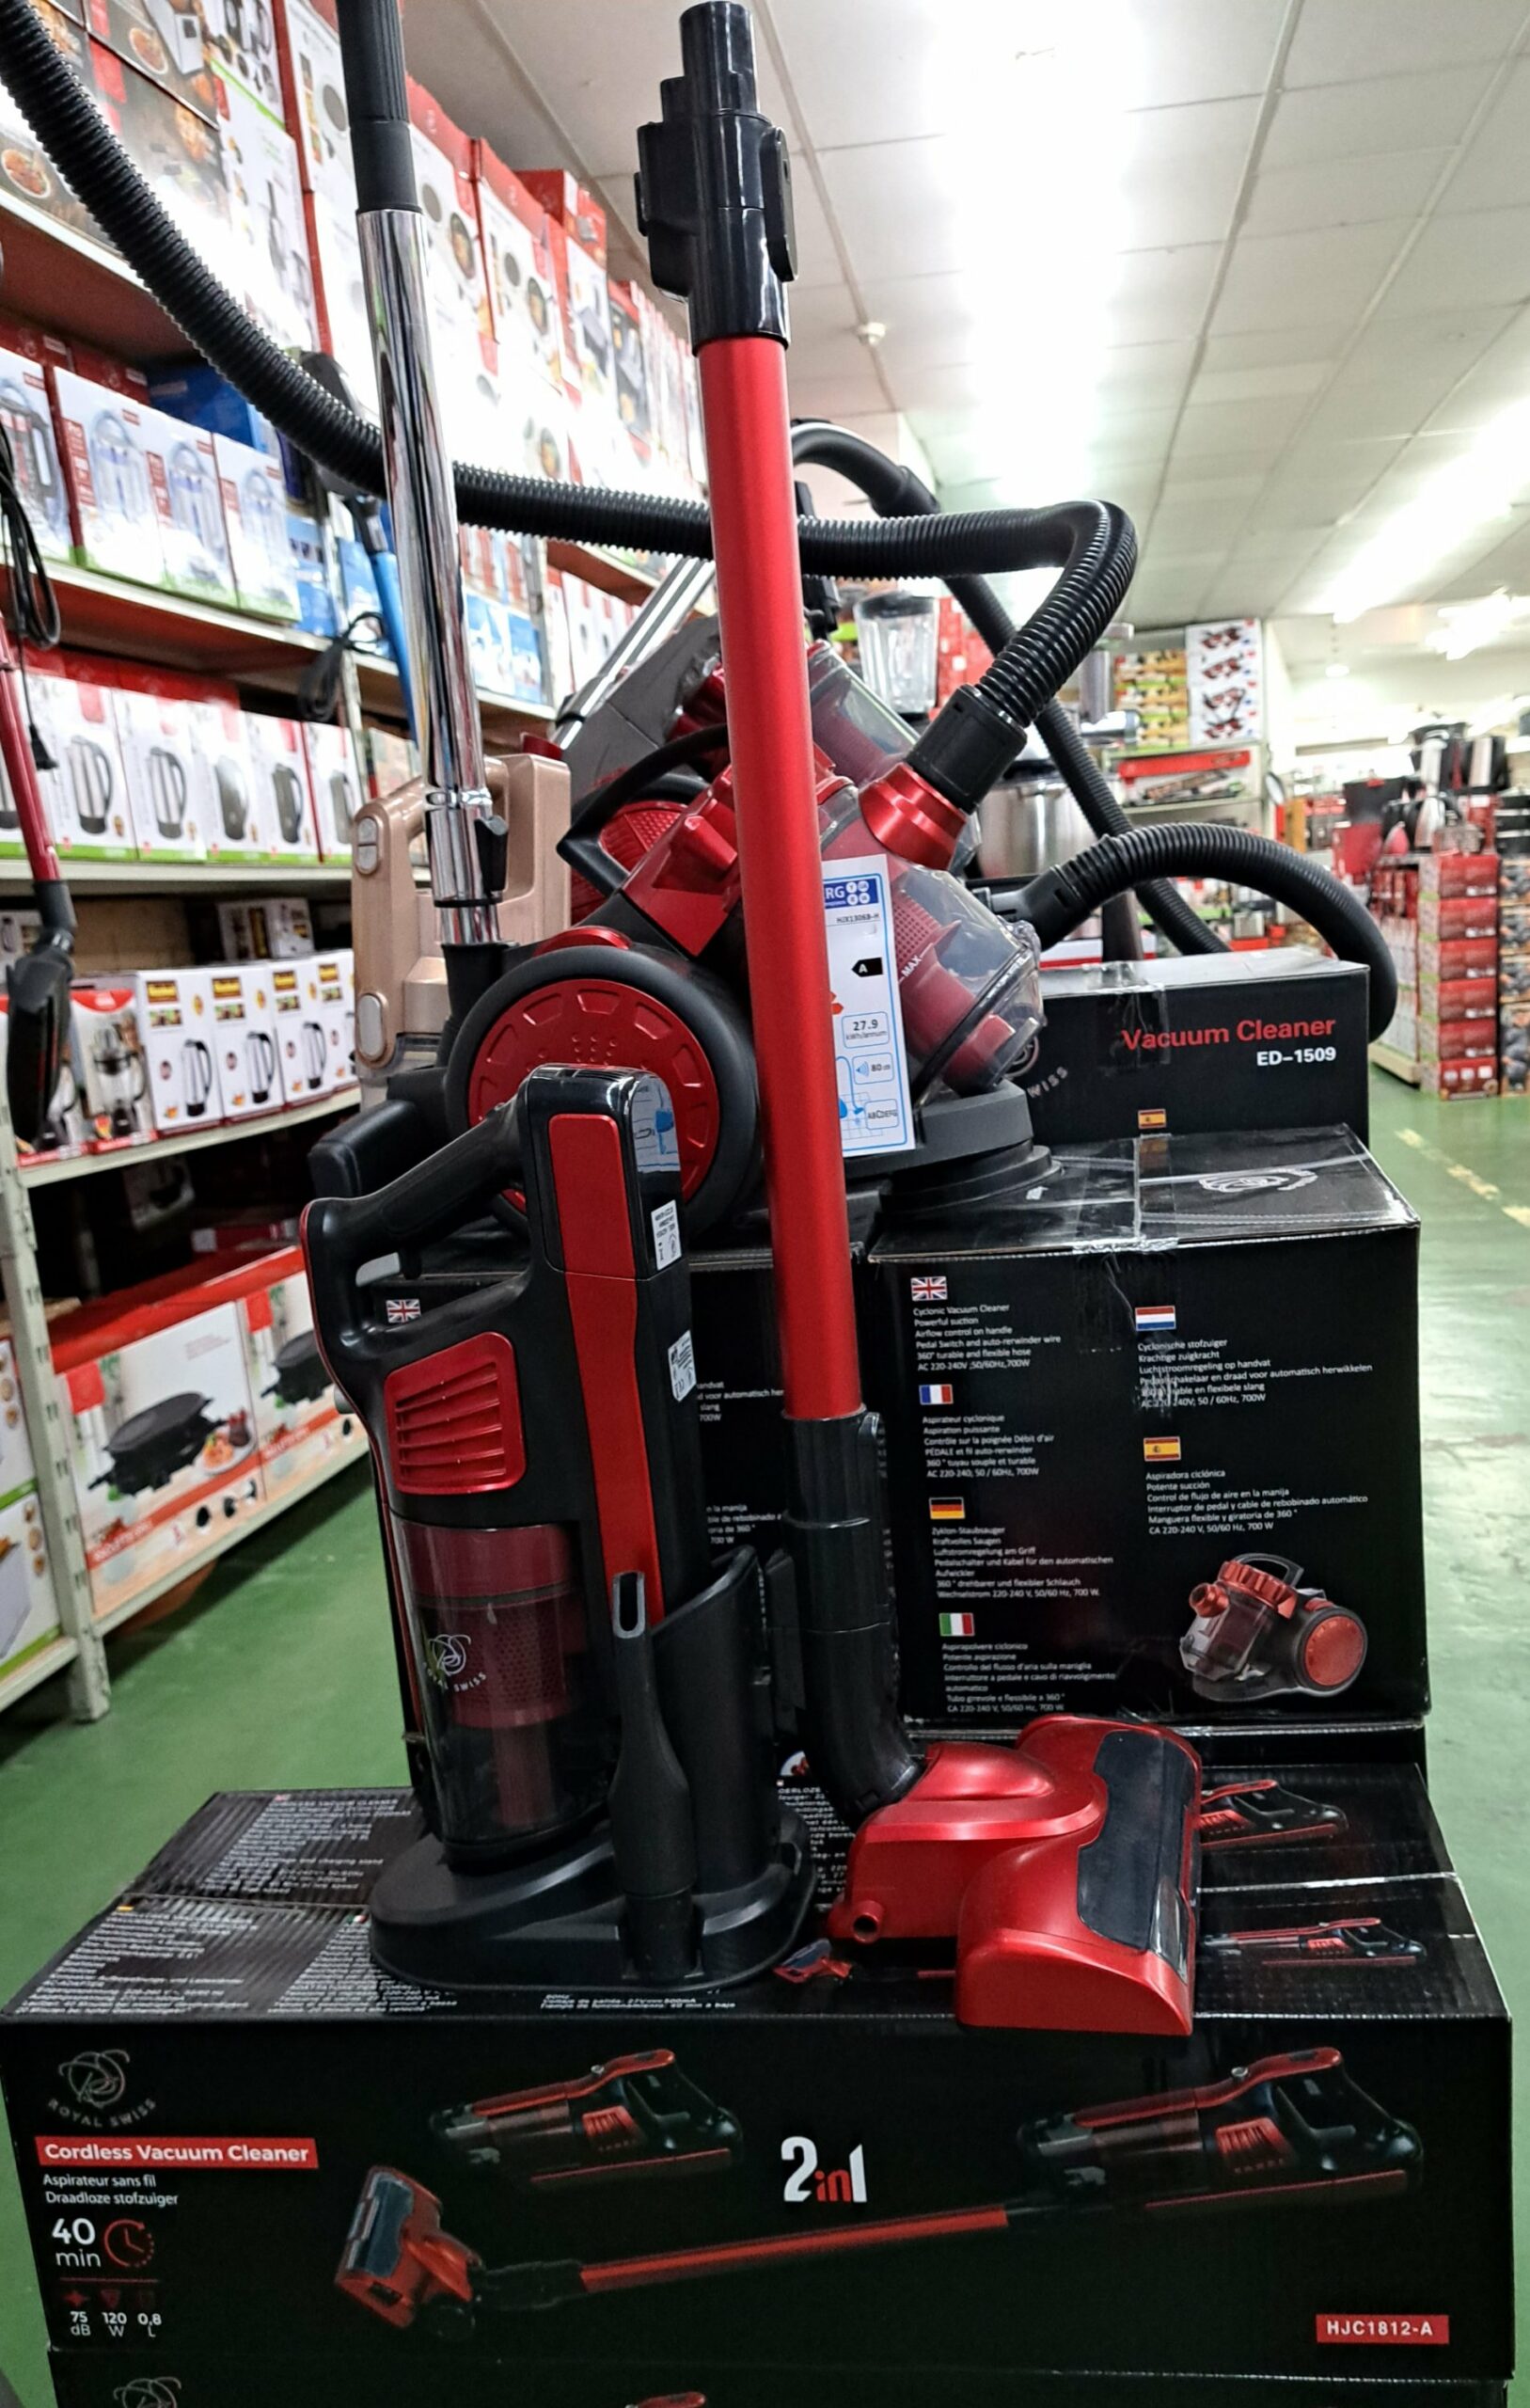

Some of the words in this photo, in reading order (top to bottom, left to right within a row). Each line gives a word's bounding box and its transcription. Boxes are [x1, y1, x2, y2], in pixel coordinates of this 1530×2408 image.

[859, 963, 867, 973] A
[902, 956, 922, 977] MAX
[852, 1020, 878, 1031] 27.9
[1123, 1029, 1228, 1050] Vacuum
[1237, 1018, 1336, 1042] Cleaner
[1256, 1046, 1337, 1067] ED-1509
[1027, 1066, 1068, 1099] WISS
[912, 1307, 944, 1316] Cyclonic
[944, 1328, 971, 1337] control
[1137, 1341, 1185, 1353] Cyclonische
[1187, 1339, 1228, 1348] stofzuiger
[1139, 1352, 1175, 1363] Krachtige
[1178, 1351, 1220, 1361] zuigkracht
[1238, 1359, 1271, 1368] handvat
[1223, 1371, 1247, 1380] draad
[1270, 1368, 1320, 1377] automatisch
[1145, 1471, 1189, 1481] Aspiradora
[1147, 1494, 1175, 1502] Control
[1191, 1492, 1208, 1500] flujo
[1147, 1504, 1191, 1513] Interruptor
[1207, 1502, 1228, 1511] pedal
[1238, 1500, 1258, 1509] cable
[1273, 1498, 1319, 1507] rebobinado
[1322, 1496, 1368, 1504] automático
[1148, 1514, 1189, 1525] Manguera
[1228, 1512, 1261, 1522] giratoria
[453, 1671, 487, 1692] SWISS
[48, 2098, 103, 2128] ROYAL
[110, 2099, 156, 2128] SWISS
[44, 2144, 134, 2161] Cordless
[136, 2145, 224, 2161] Vacuum
[228, 2145, 308, 2162] Cleaner
[43, 2174, 109, 2189] Aspirateur
[111, 2177, 141, 2188] sans
[143, 2175, 156, 2188] fil
[45, 2192, 111, 2205] Draadloze
[113, 2192, 179, 2208] stofzuiger
[51, 2218, 96, 2244] 40
[55, 2248, 102, 2267] min
[70, 2310, 88, 2323] 75
[102, 2312, 128, 2325] 120
[70, 2323, 90, 2337] dB
[109, 2325, 124, 2337] W
[149, 2325, 156, 2337] L
[1326, 2320, 1434, 2338] HJC1812-A
